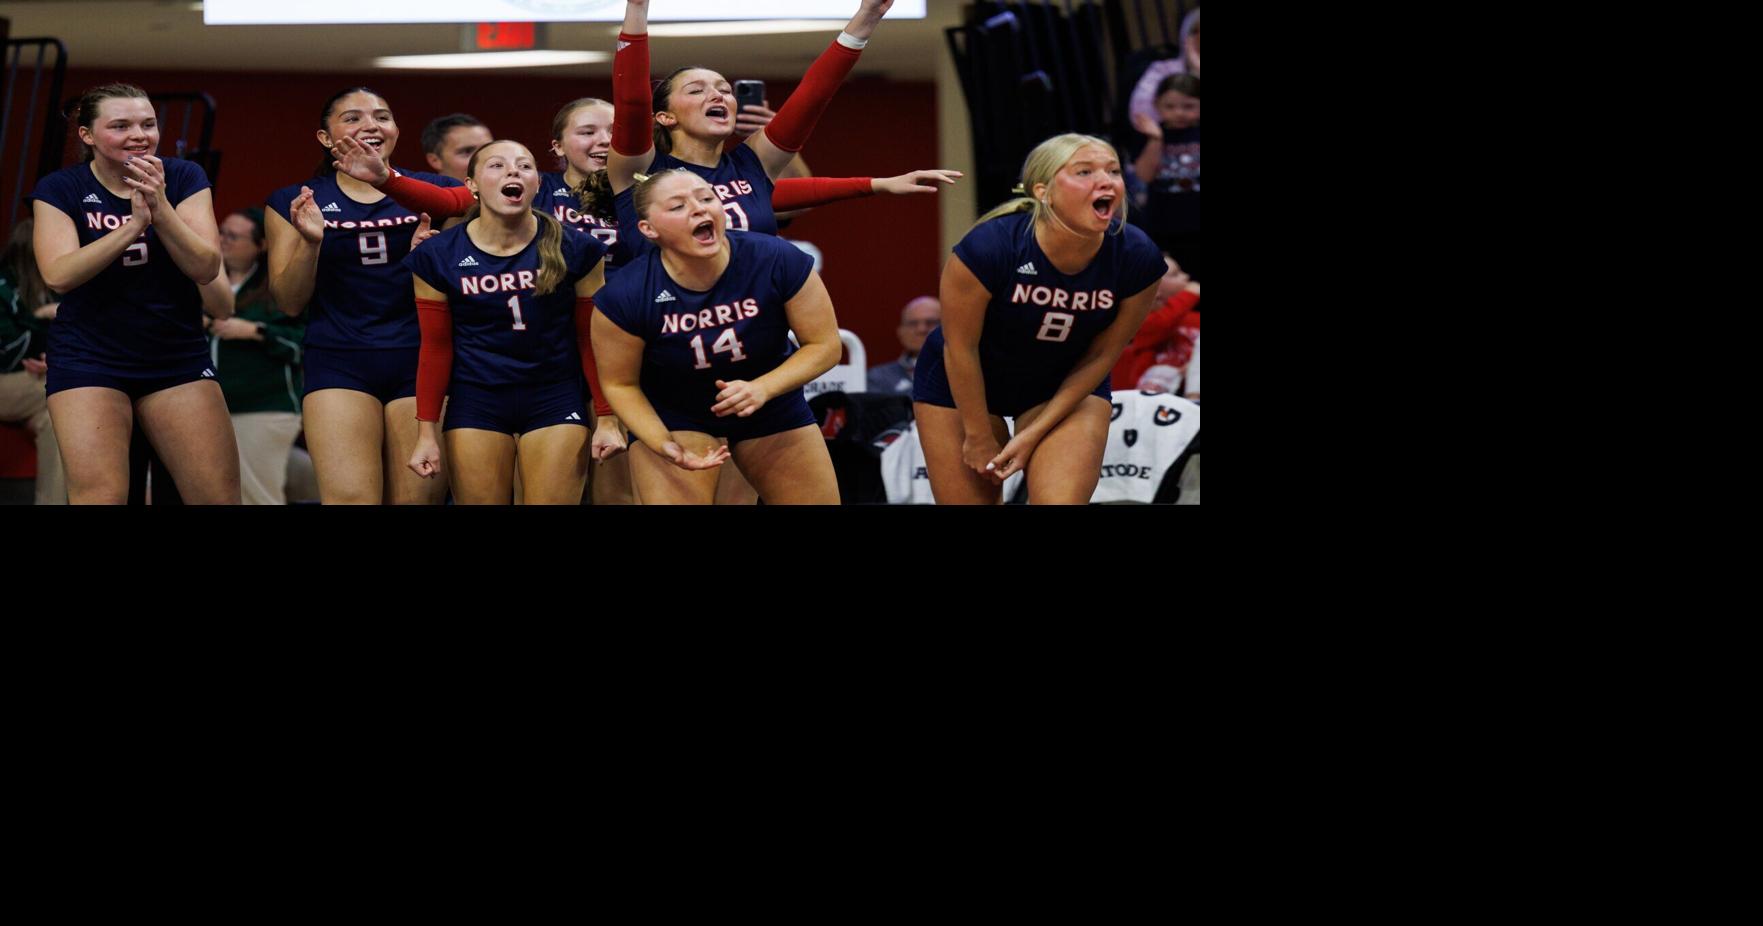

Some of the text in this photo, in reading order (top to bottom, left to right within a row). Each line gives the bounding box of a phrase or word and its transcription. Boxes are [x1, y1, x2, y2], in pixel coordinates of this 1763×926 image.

[708, 180, 753, 200] RIS
[359, 231, 388, 265] 9
[461, 268, 543, 295] NORR
[1011, 283, 1114, 311] NORRIS
[507, 295, 526, 330] 1
[661, 298, 760, 334] NORRIS
[1036, 312, 1075, 342] 8
[690, 327, 748, 370] 14
